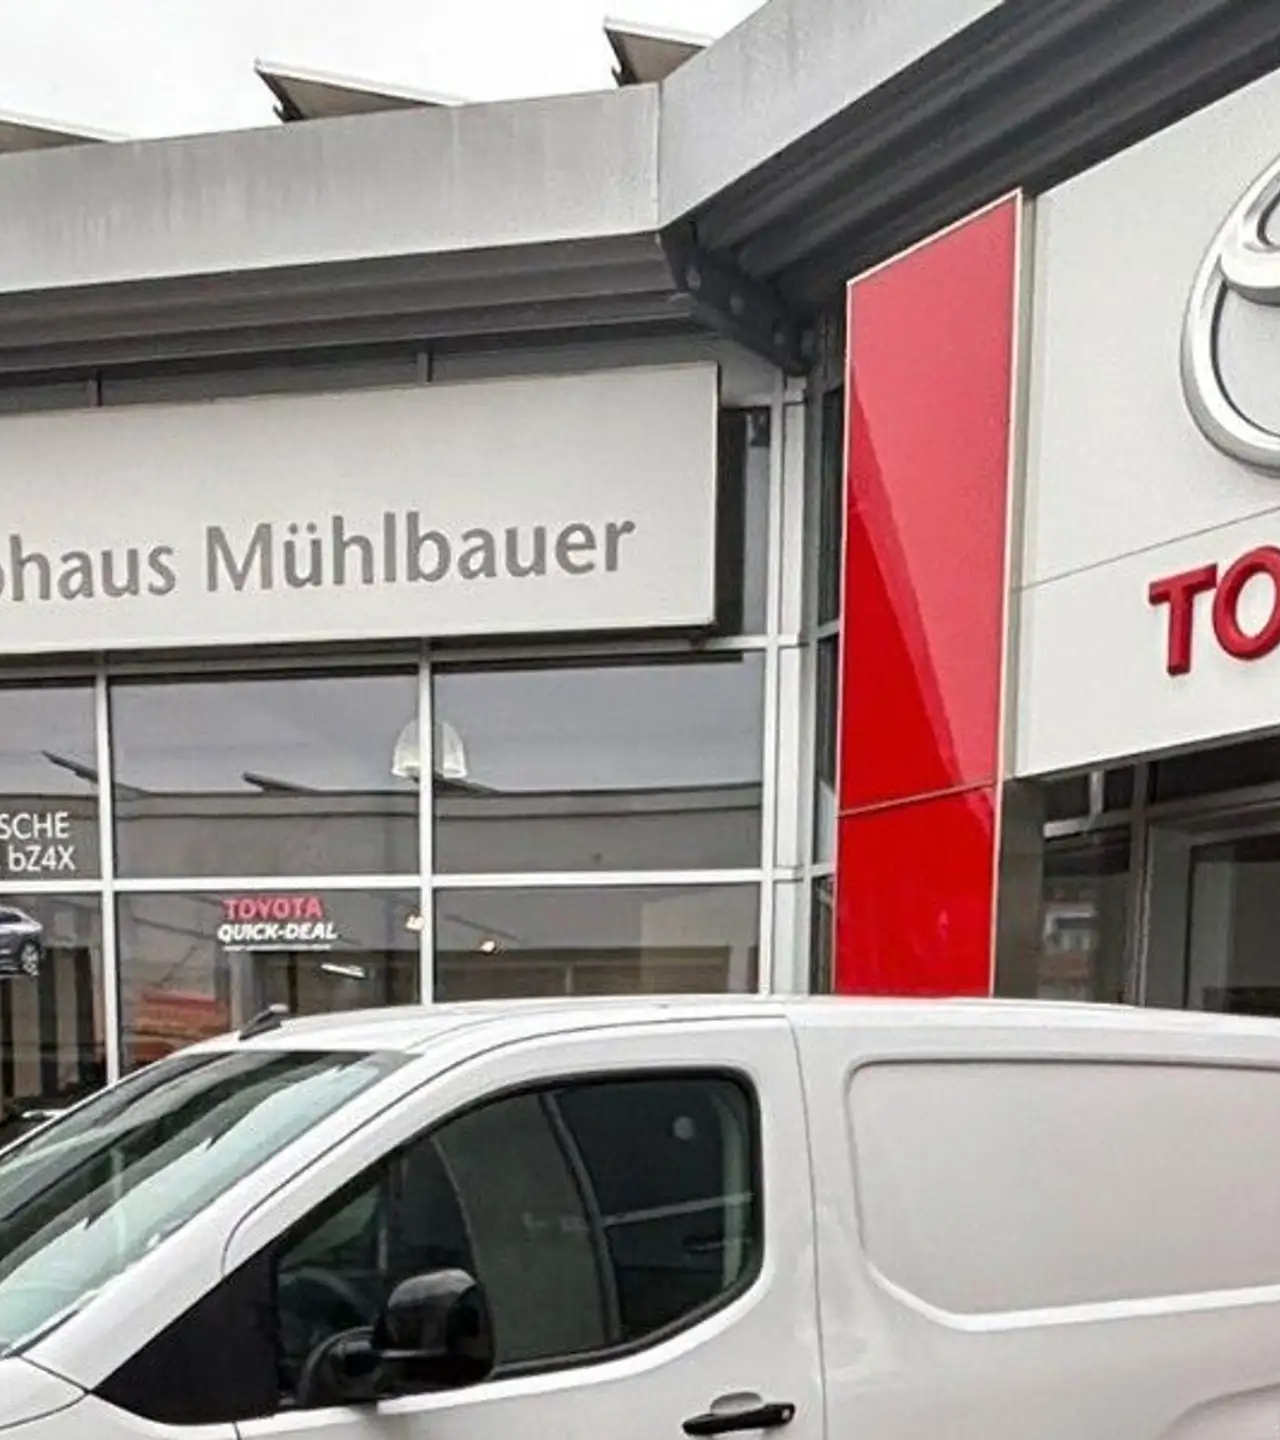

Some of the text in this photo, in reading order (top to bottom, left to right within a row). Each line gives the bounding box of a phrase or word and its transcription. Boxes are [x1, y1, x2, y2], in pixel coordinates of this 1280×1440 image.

[206, 510, 637, 592] Mühlbauer
[8, 845, 76, 872] bZ4X
[223, 897, 324, 920] TOYOTA
[217, 922, 338, 944] QUICK-DEAL
